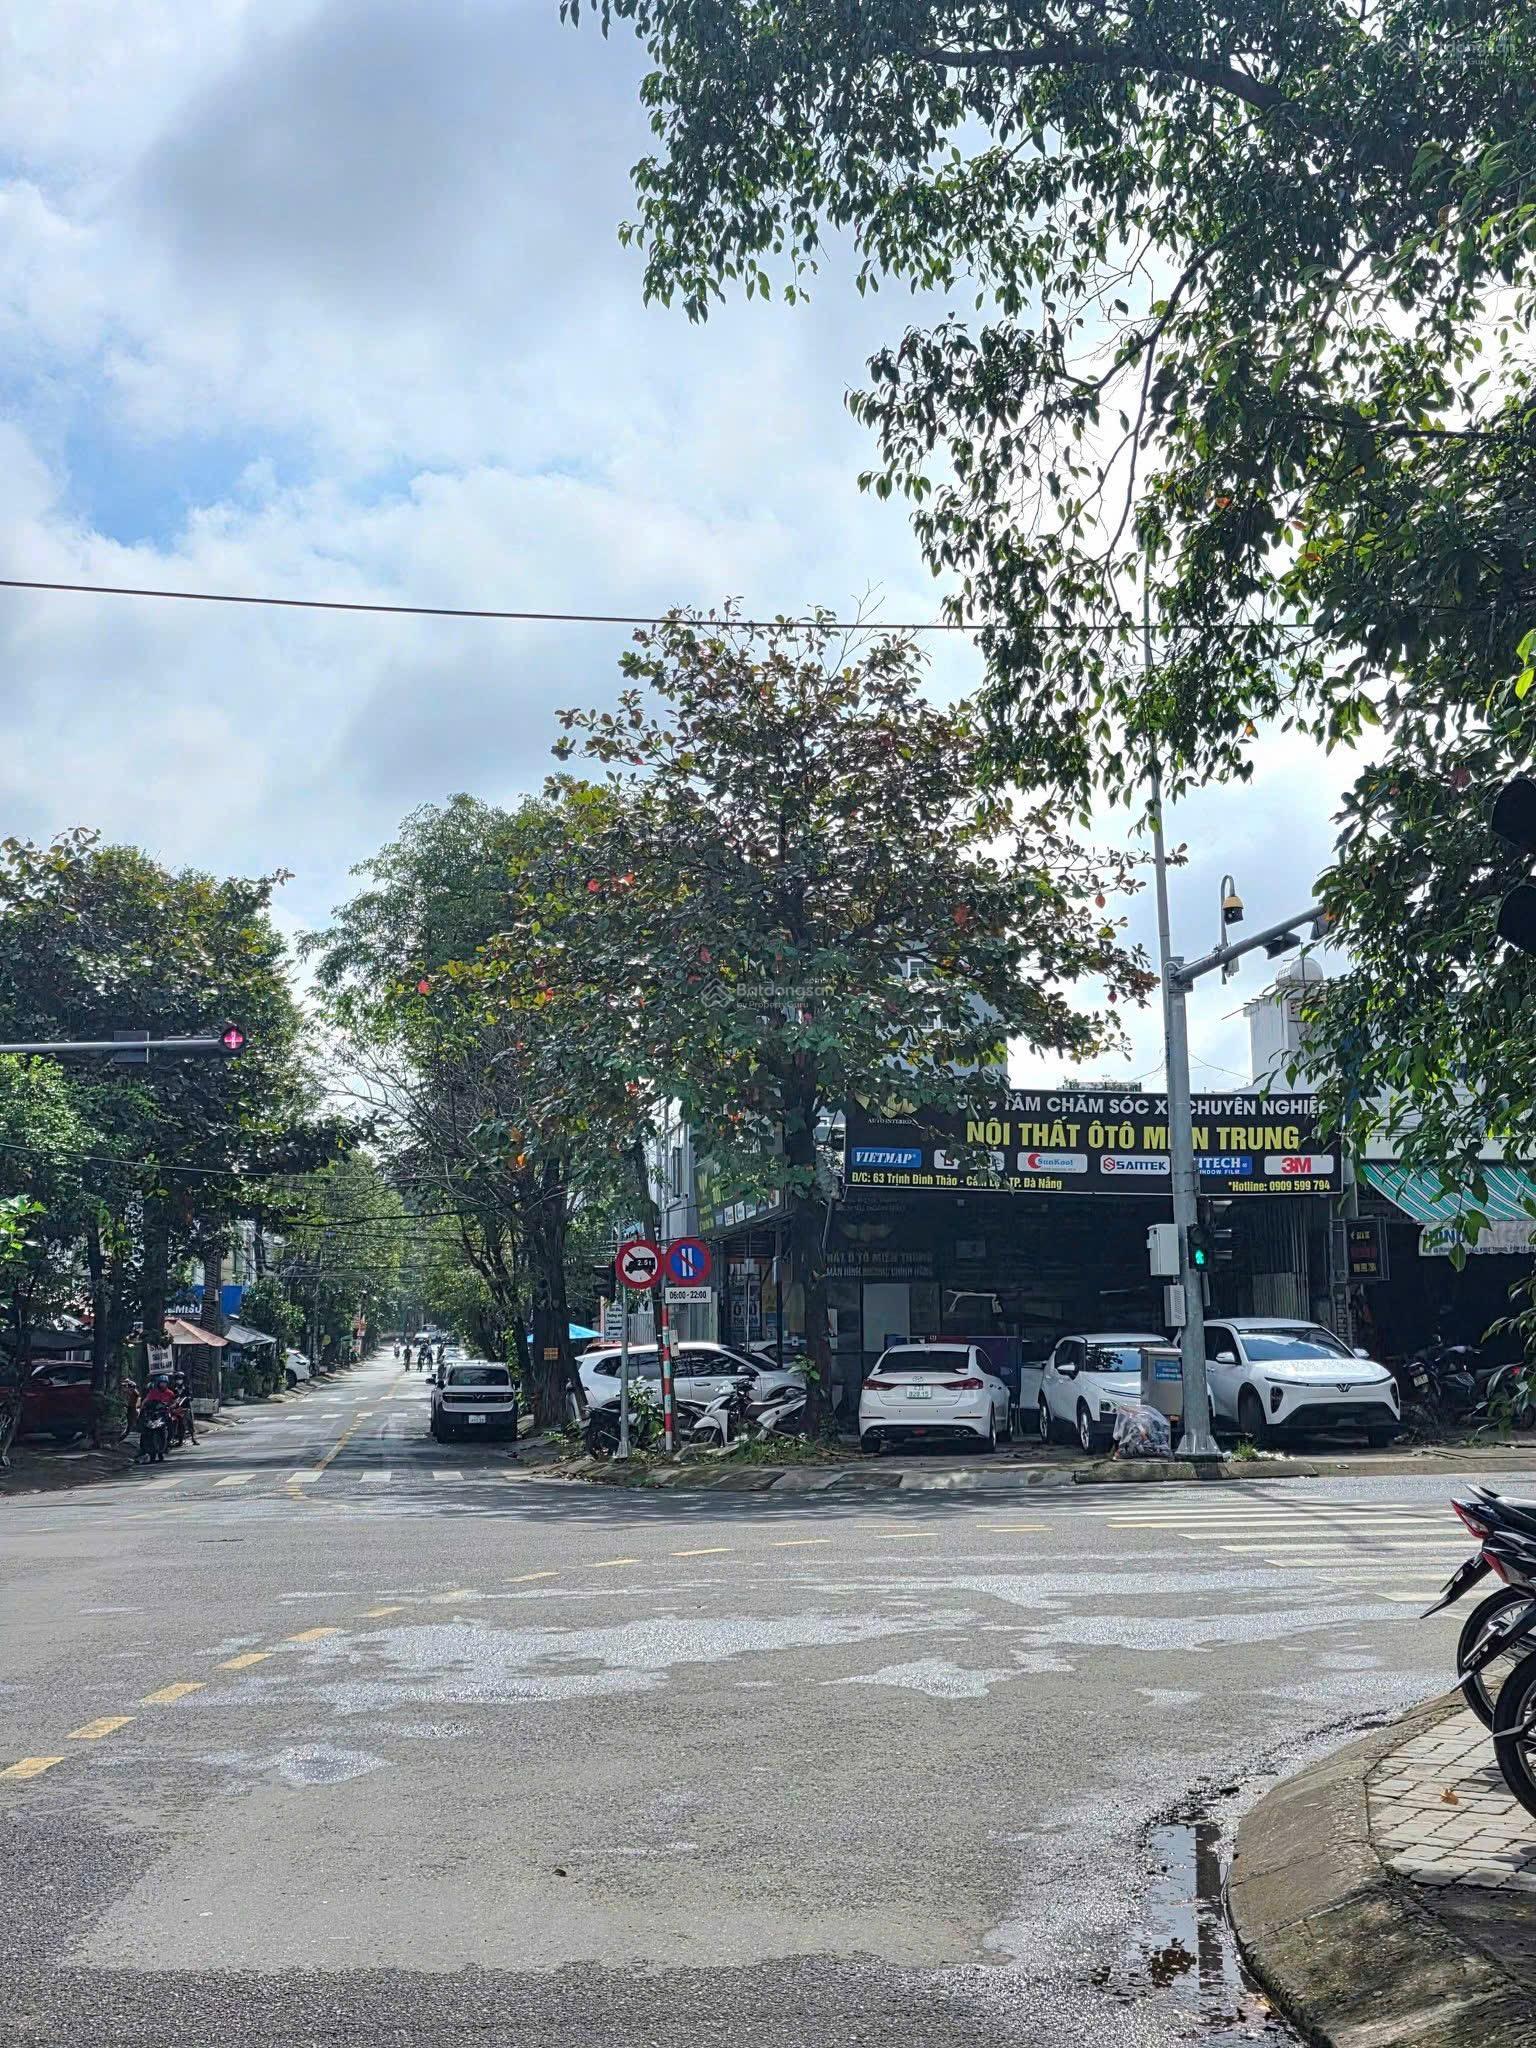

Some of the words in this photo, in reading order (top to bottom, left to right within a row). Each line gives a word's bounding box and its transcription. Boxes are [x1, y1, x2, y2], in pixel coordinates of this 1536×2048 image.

[1047, 1094, 1103, 1114] CHĂM
[1109, 1095, 1149, 1115] SÓC
[1154, 1100, 1169, 1115] X
[966, 1117, 1010, 1150] NỘI
[1018, 1115, 1081, 1148] THẤT
[1088, 1120, 1136, 1150] ÔTÔ
[1216, 1126, 1300, 1151] TRUNG
[856, 1151, 912, 1165] VIETMAP
[1281, 1157, 1312, 1174] 3M
[873, 1172, 885, 1183] 63
[887, 1173, 910, 1186] Trịnh
[1269, 1181, 1292, 1191] 0909
[1294, 1180, 1312, 1191] 599
[669, 1291, 687, 1300] 06:00
[690, 1290, 707, 1300] 22:00
